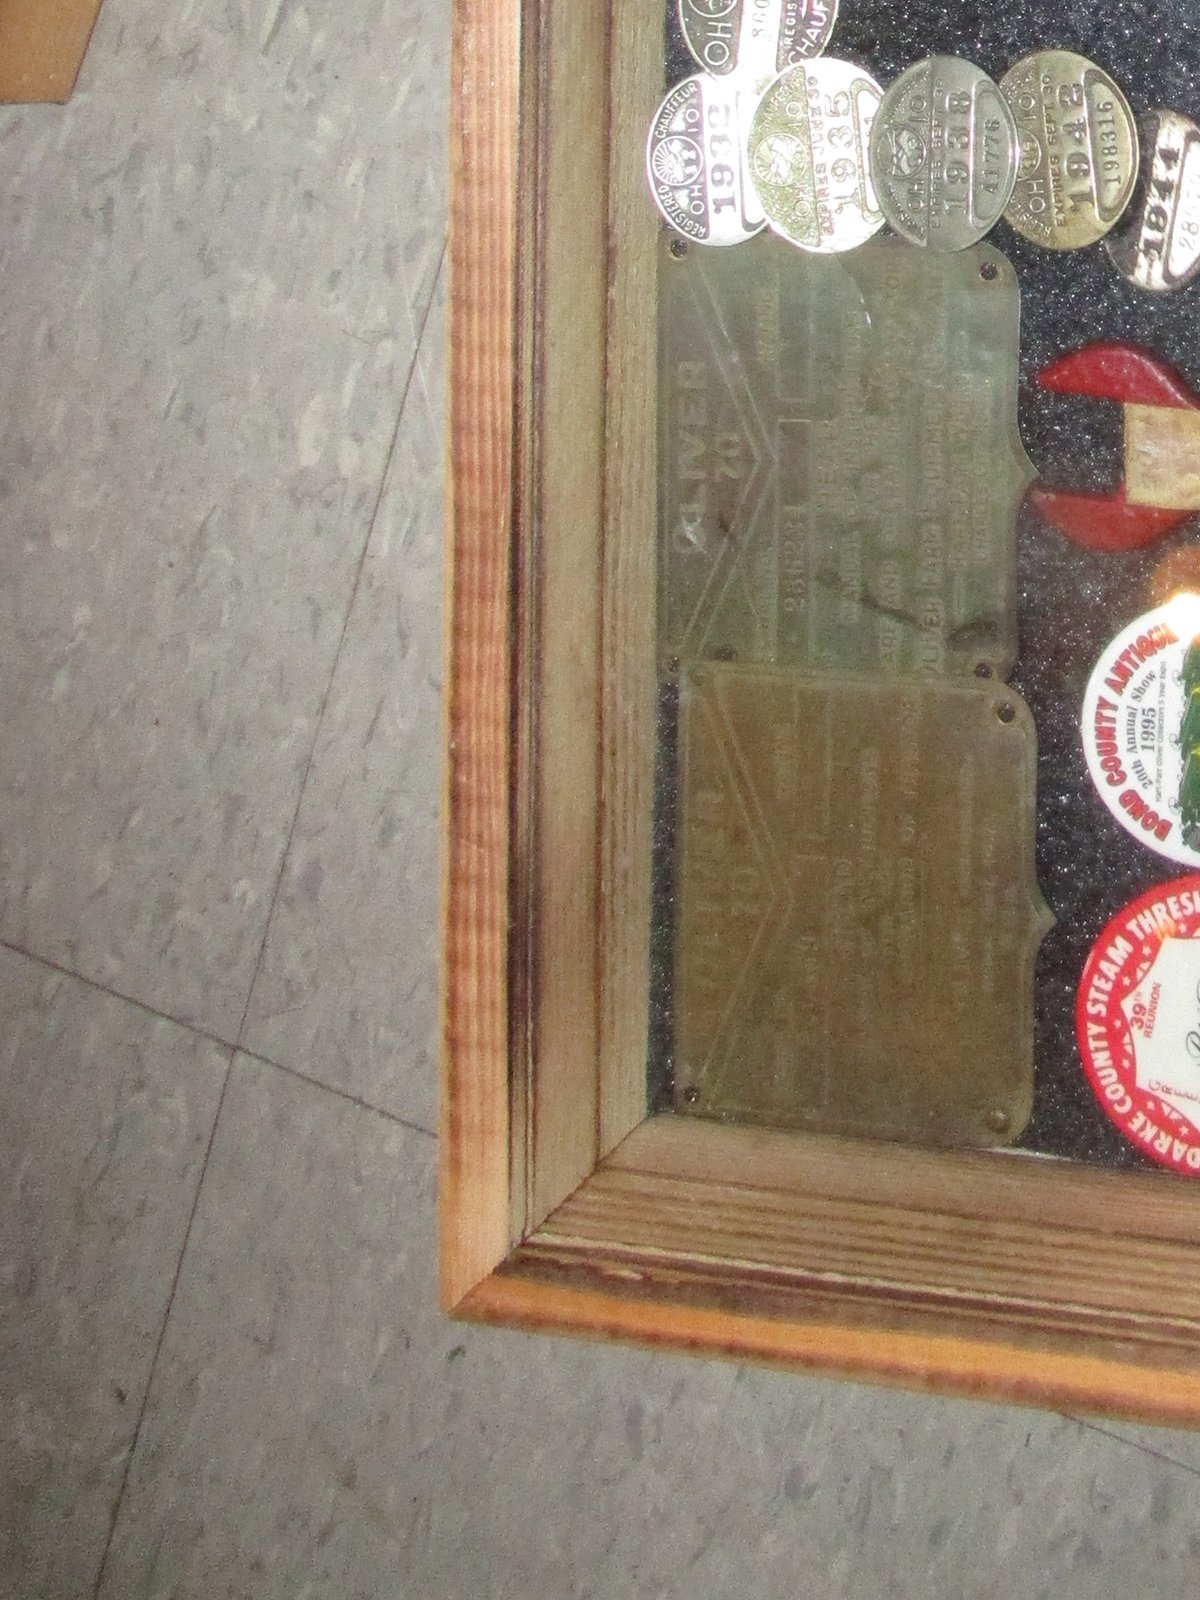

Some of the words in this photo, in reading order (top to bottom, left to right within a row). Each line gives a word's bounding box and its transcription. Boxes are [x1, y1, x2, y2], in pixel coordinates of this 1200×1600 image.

[656, 80, 699, 138] CHAUFFEUR
[1096, 100, 1122, 184] 198316
[707, 104, 737, 214] 1932
[825, 90, 860, 216] 1935
[944, 90, 971, 215] 1938
[982, 118, 1001, 195] 41776
[1057, 82, 1095, 213] 1942
[658, 185, 707, 237] REGISTERED
[931, 159, 943, 229] EXPIRES
[1050, 154, 1067, 228] EXPIRES
[1130, 670, 1157, 702] Show
[1094, 694, 1127, 787] COUNTY
[1125, 704, 1139, 754] Annual
[1140, 706, 1157, 752] 1995
[1131, 759, 1154, 790] 20th
[1118, 788, 1173, 842] BOND
[1086, 934, 1133, 1017] STEAM
[1142, 981, 1163, 1039] REUNION
[1086, 1022, 1132, 1114] COUNTY
